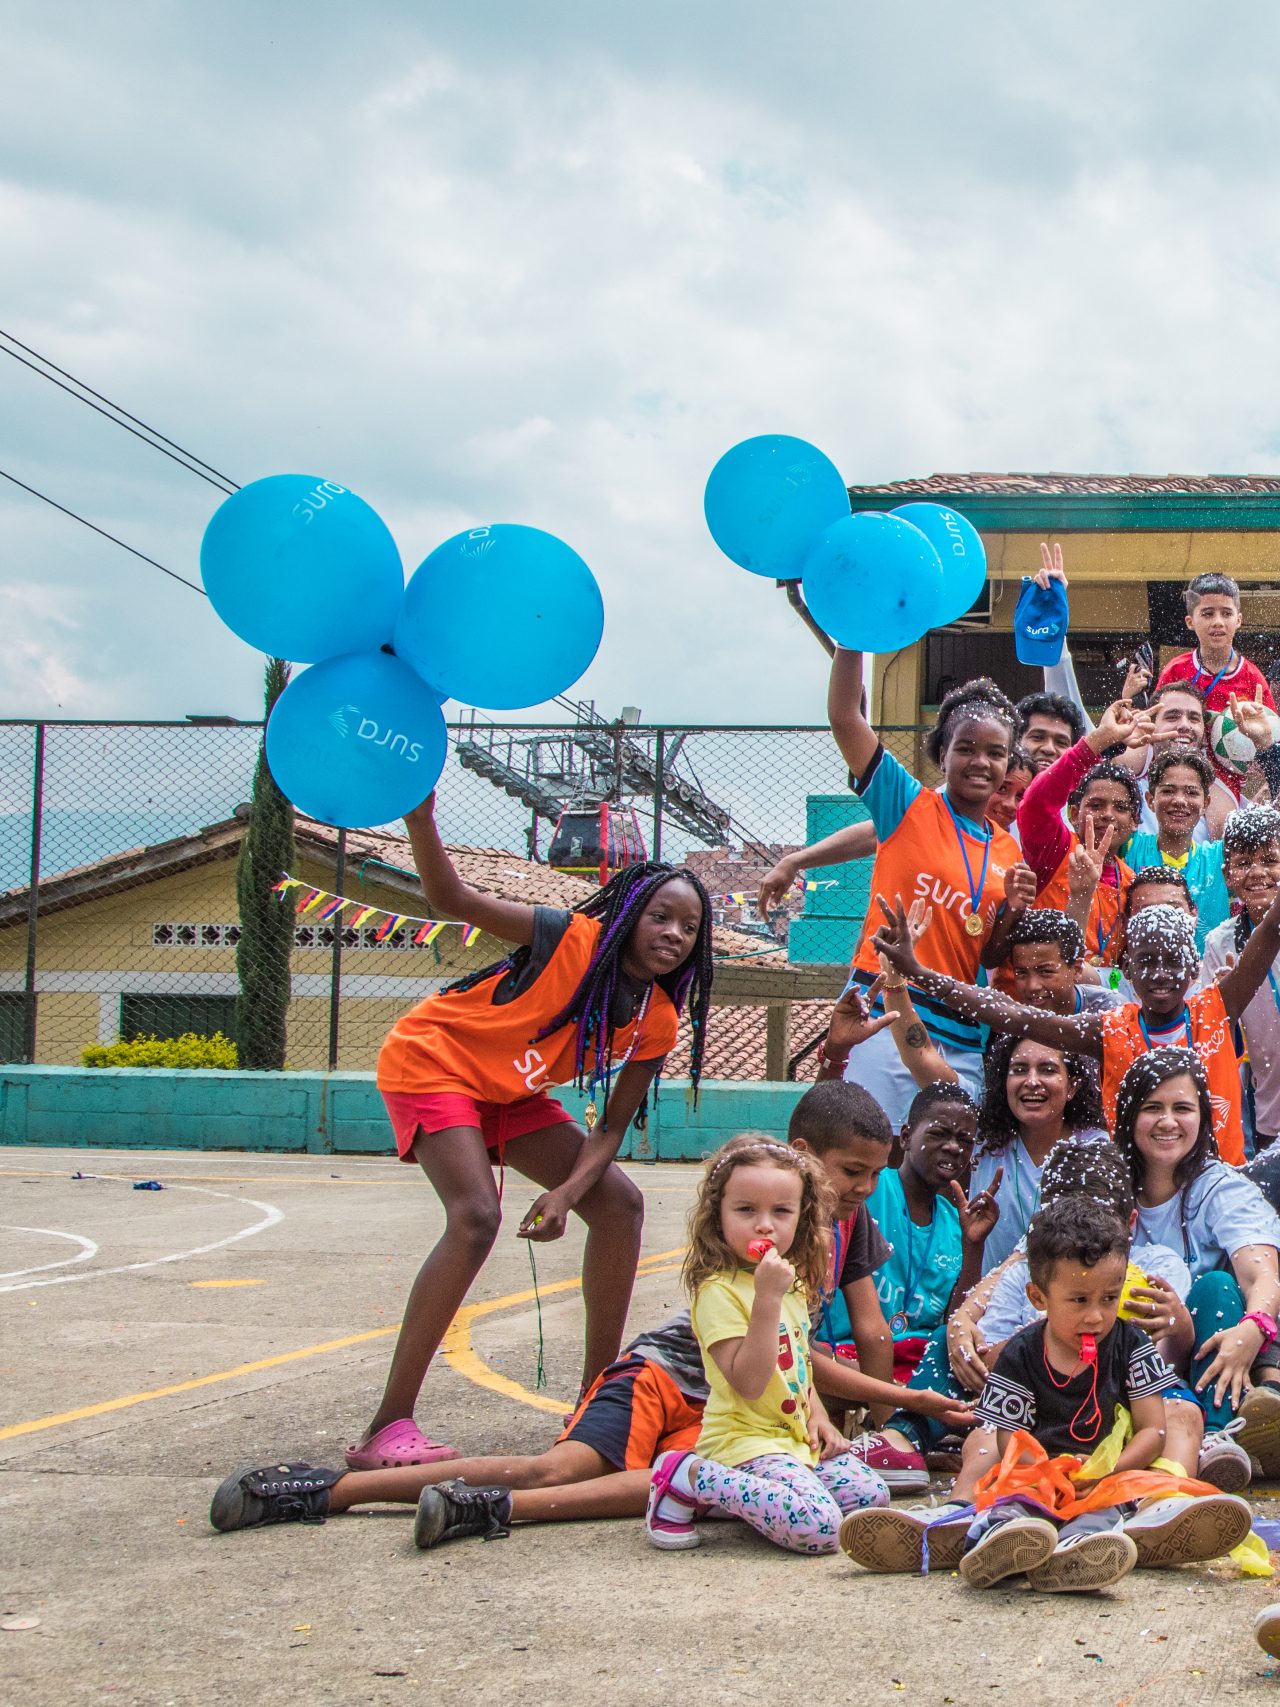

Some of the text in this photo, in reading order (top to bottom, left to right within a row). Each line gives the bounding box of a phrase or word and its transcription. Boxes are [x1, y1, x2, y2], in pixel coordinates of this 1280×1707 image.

[291, 481, 346, 525] sura
[939, 512, 966, 557] sura
[1026, 625, 1049, 635] sura
[357, 717, 424, 762] sura
[876, 1275, 925, 1319] ura
